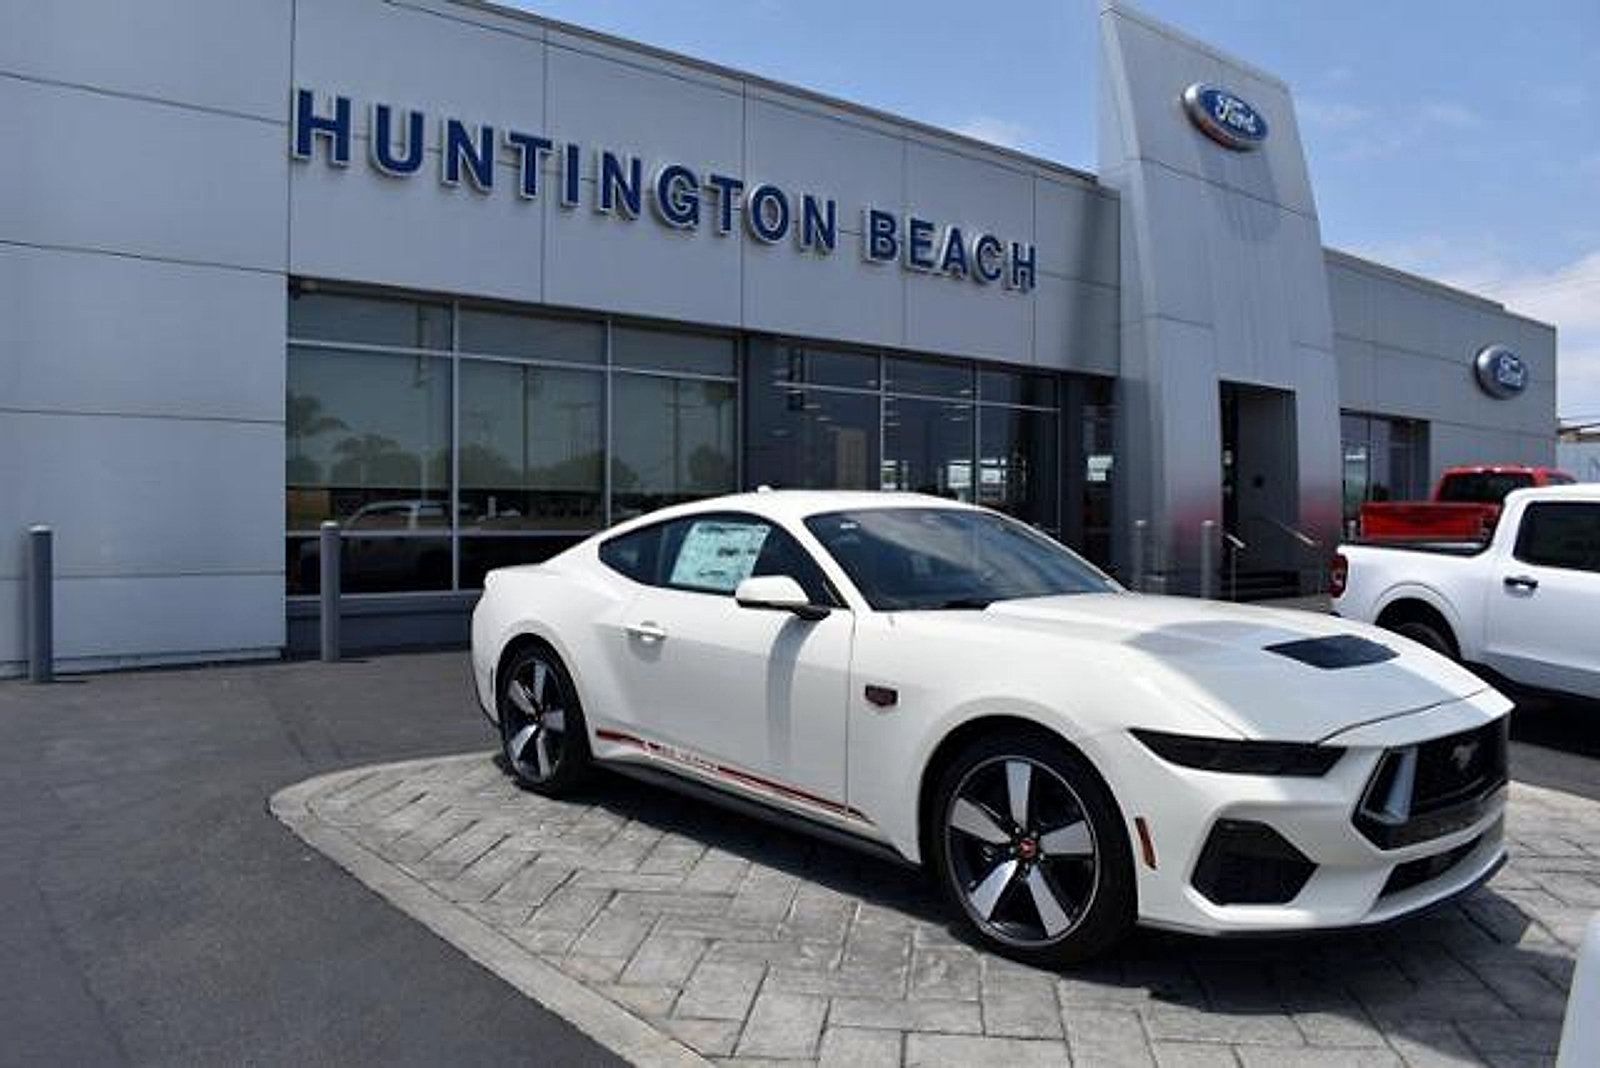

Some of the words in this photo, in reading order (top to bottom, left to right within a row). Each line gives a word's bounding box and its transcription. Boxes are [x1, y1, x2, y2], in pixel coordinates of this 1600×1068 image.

[1214, 94, 1258, 133] Ford
[292, 88, 838, 253] HUNTINGTON
[864, 206, 1037, 291] BEACH
